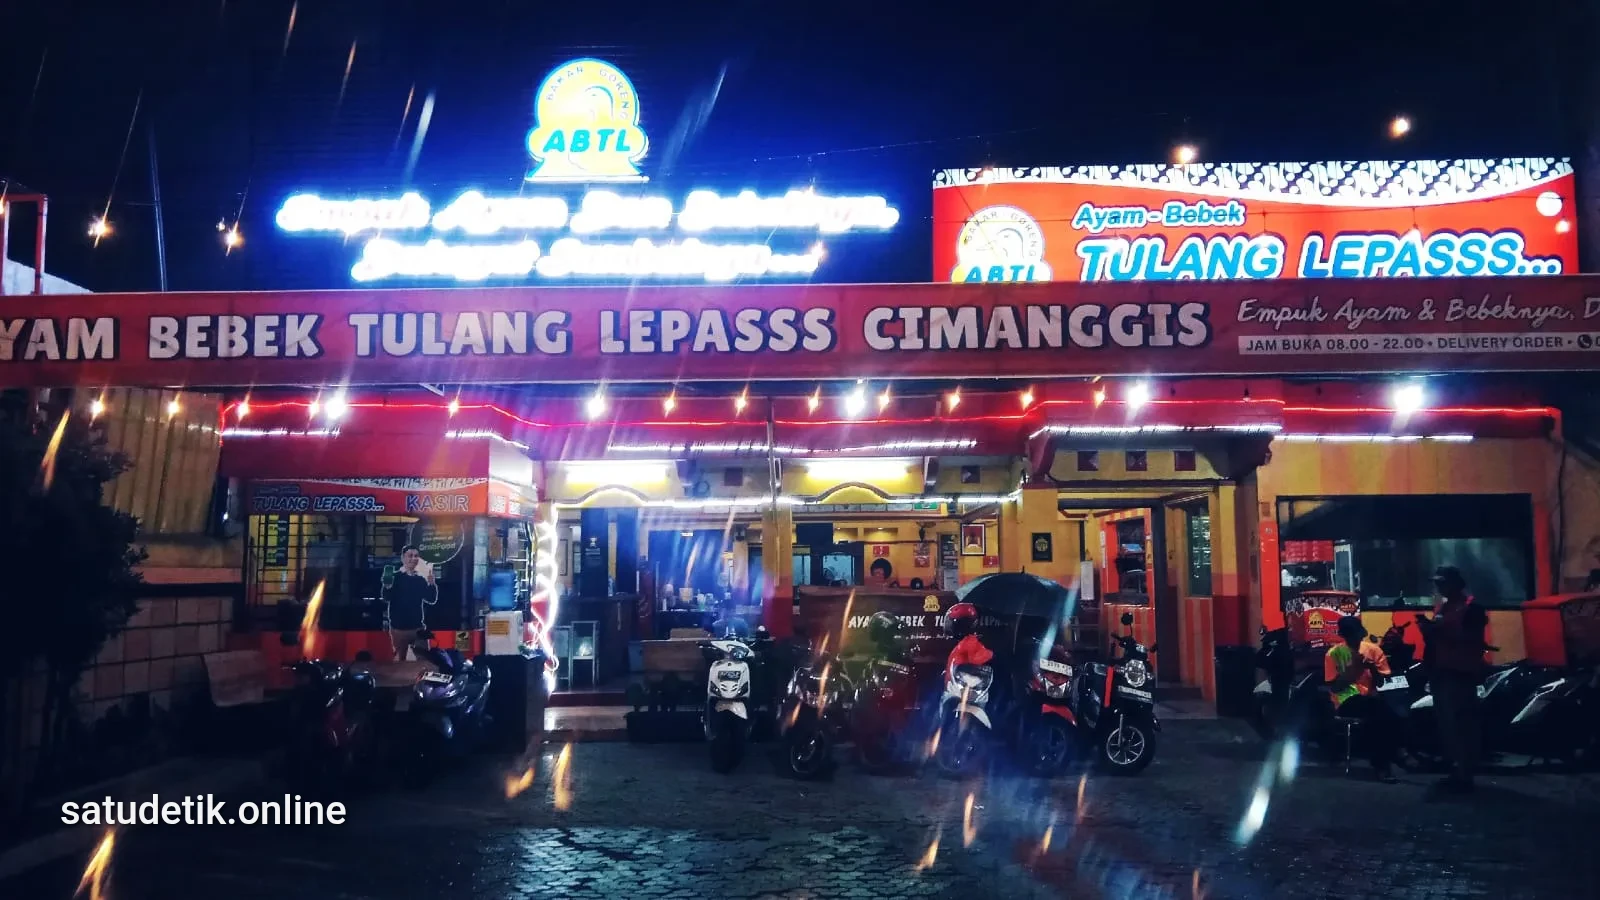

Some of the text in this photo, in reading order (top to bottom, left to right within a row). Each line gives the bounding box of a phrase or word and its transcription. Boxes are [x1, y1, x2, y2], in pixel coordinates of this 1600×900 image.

[546, 65, 629, 120] BAKAR GORENG
[543, 129, 630, 152] ABTL
[1074, 205, 1145, 230] Ayam
[1163, 202, 1244, 224] Bebek
[1080, 235, 1558, 281] TULANG LEPASSS...
[1237, 296, 1328, 330] Empuk
[1333, 297, 1411, 330] Ayam
[1417, 298, 1437, 321] &
[1445, 294, 1575, 329] Bebeknya,
[148, 314, 320, 359] BEBEK
[349, 311, 569, 357] TULANG
[600, 308, 836, 354] LEPASSS
[863, 302, 1209, 350] CIMANGGIS
[1246, 340, 1277, 351] JAM
[1282, 339, 1322, 350] BUKA
[1326, 338, 1369, 350] 08.00
[1383, 338, 1424, 349] 22.00
[1437, 337, 1508, 349] DELIVERY
[1512, 336, 1563, 348] ORDER
[253, 495, 308, 512] TULANG
[405, 495, 469, 512] KASIR
[847, 615, 871, 629] AYA
